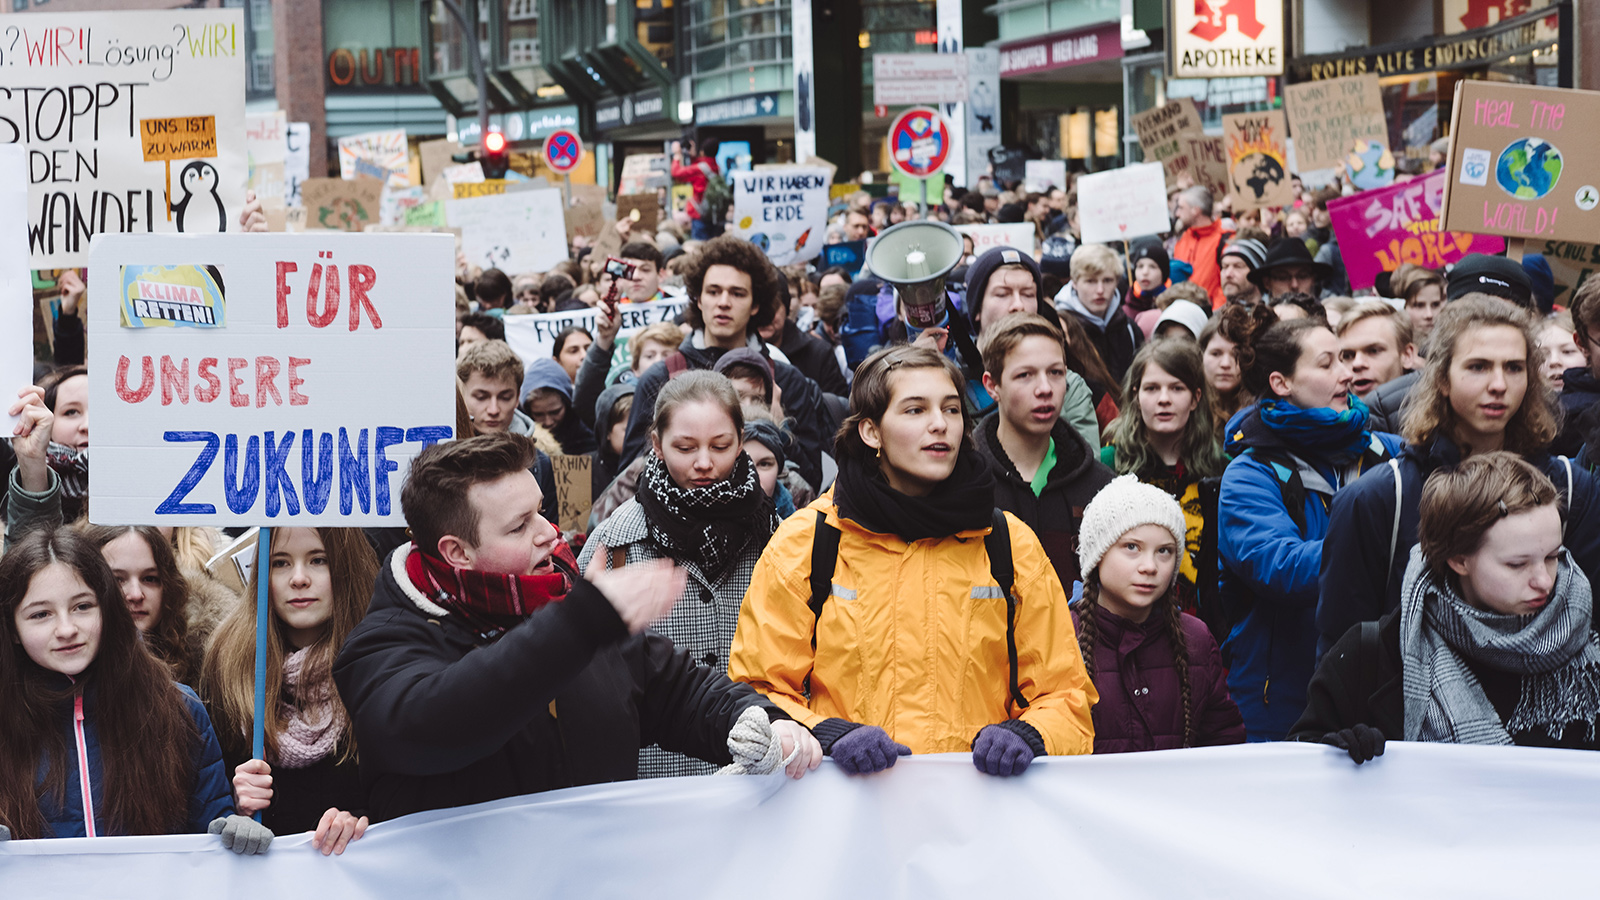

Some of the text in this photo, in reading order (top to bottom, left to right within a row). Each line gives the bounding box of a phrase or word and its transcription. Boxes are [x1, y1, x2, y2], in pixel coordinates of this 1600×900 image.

[23, 26, 84, 67] WIR!
[86, 24, 186, 82] Lösung?
[187, 22, 236, 59] WIR!
[1181, 47, 1277, 68] APOTHEKE
[146, 117, 209, 135] UNS IST
[146, 139, 215, 155] ZU WARM!
[1187, 138, 1227, 163] TIME
[29, 148, 98, 184] DEN
[744, 174, 824, 193] WIR HABEN
[763, 205, 804, 221] ERDE
[1365, 170, 1446, 239] SAFE
[1404, 217, 1441, 236] THE
[1483, 200, 1558, 235] WORLD!
[140, 282, 203, 304] KLIMA
[275, 250, 383, 332] FÜR
[134, 299, 214, 324] RETTEN!
[582, 308, 651, 338] UERE
[114, 354, 312, 409] UNSERE
